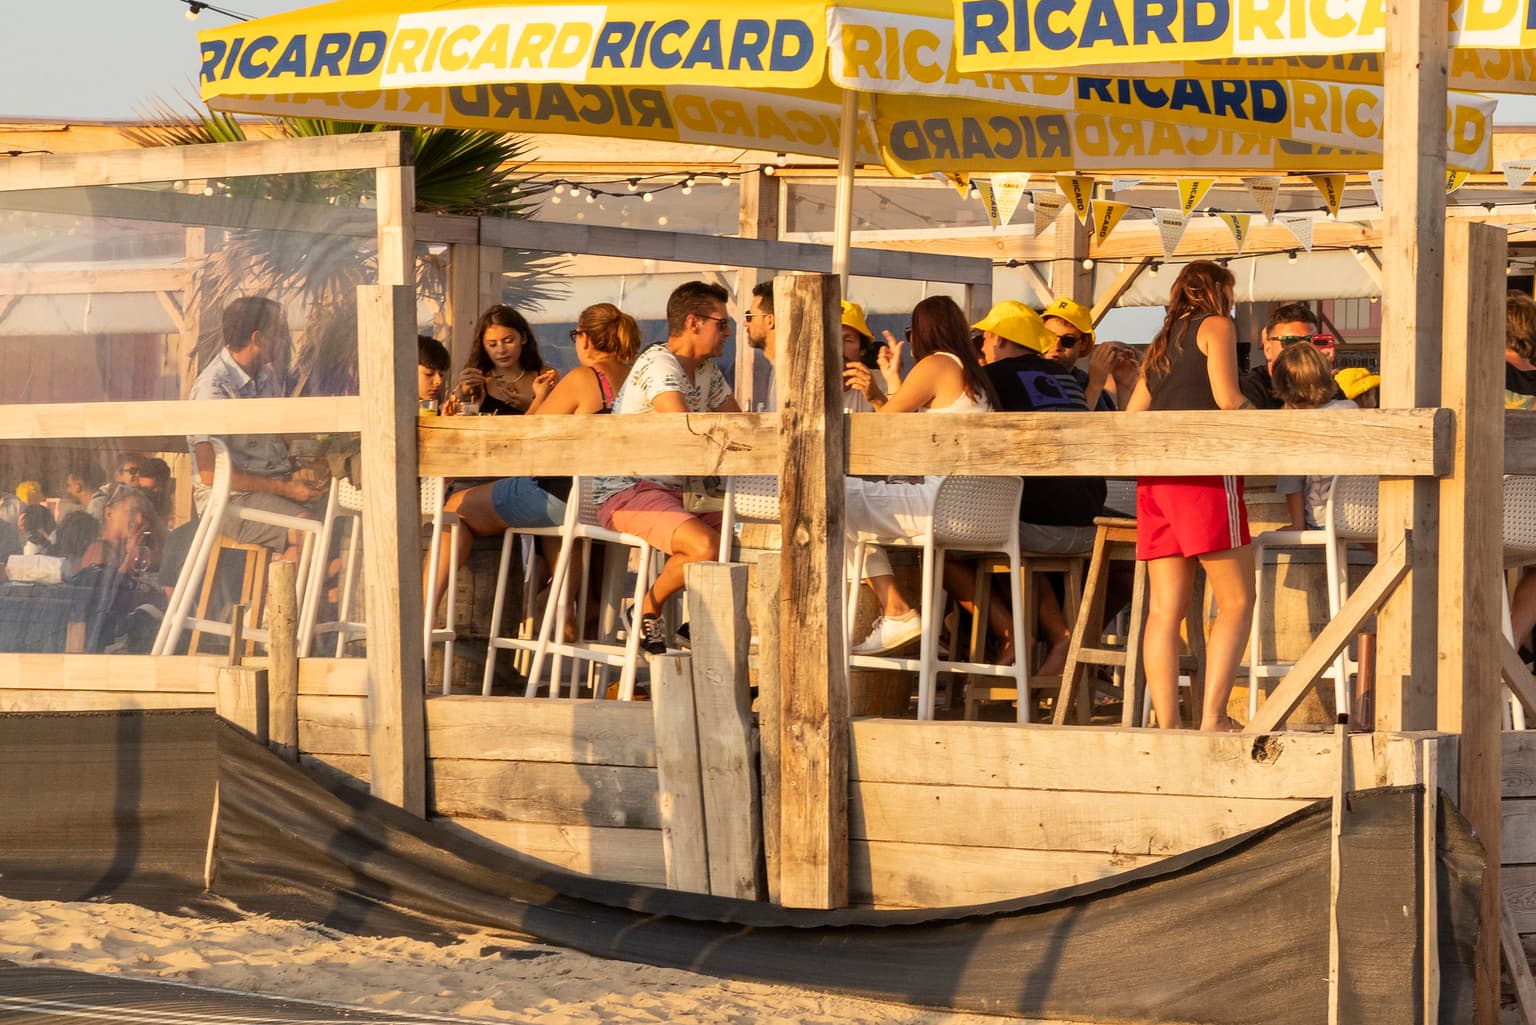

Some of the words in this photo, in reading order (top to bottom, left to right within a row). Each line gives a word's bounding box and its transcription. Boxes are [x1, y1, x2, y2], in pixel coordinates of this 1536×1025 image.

[200, 30, 387, 83] RICARD
[385, 22, 594, 74] RICARD
[590, 18, 815, 72] RICARD
[1291, 82, 1486, 156] RICD
[1072, 179, 1084, 211] RICARD
[1185, 181, 1198, 210] RICARD
[1100, 206, 1113, 238] RICARD
